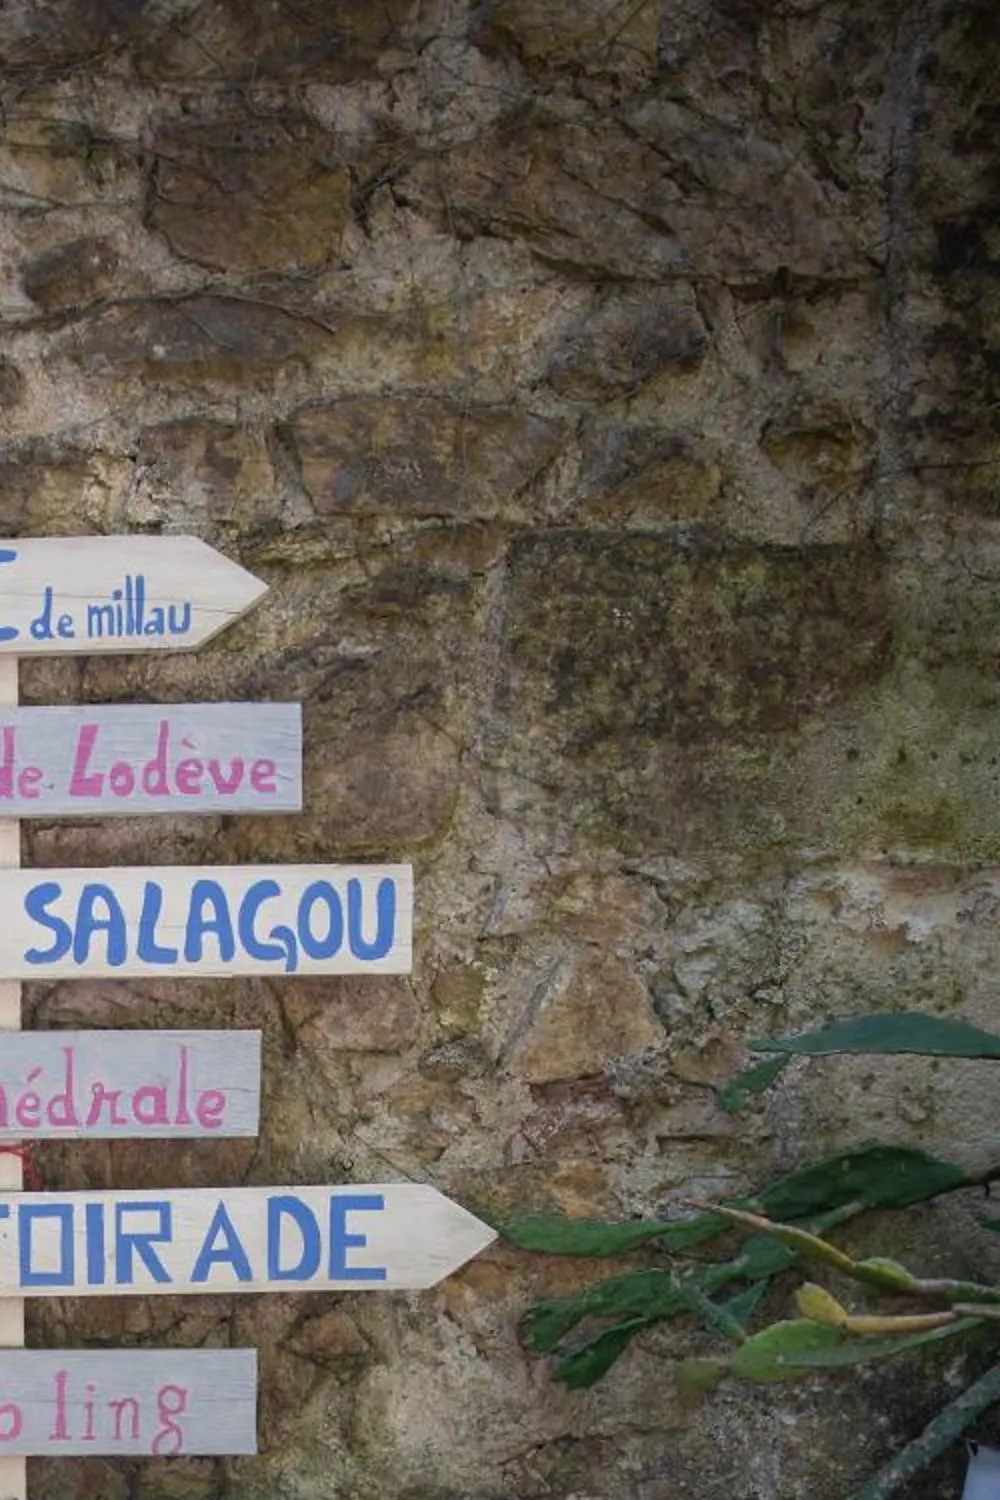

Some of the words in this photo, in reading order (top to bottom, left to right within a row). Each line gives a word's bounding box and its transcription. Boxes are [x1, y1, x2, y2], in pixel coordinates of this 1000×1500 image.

[29, 586, 75, 640] de
[86, 575, 191, 637] millau
[68, 720, 278, 798] Lodève
[23, 878, 395, 972] SALAGOU
[48, 1369, 188, 1455] ling
